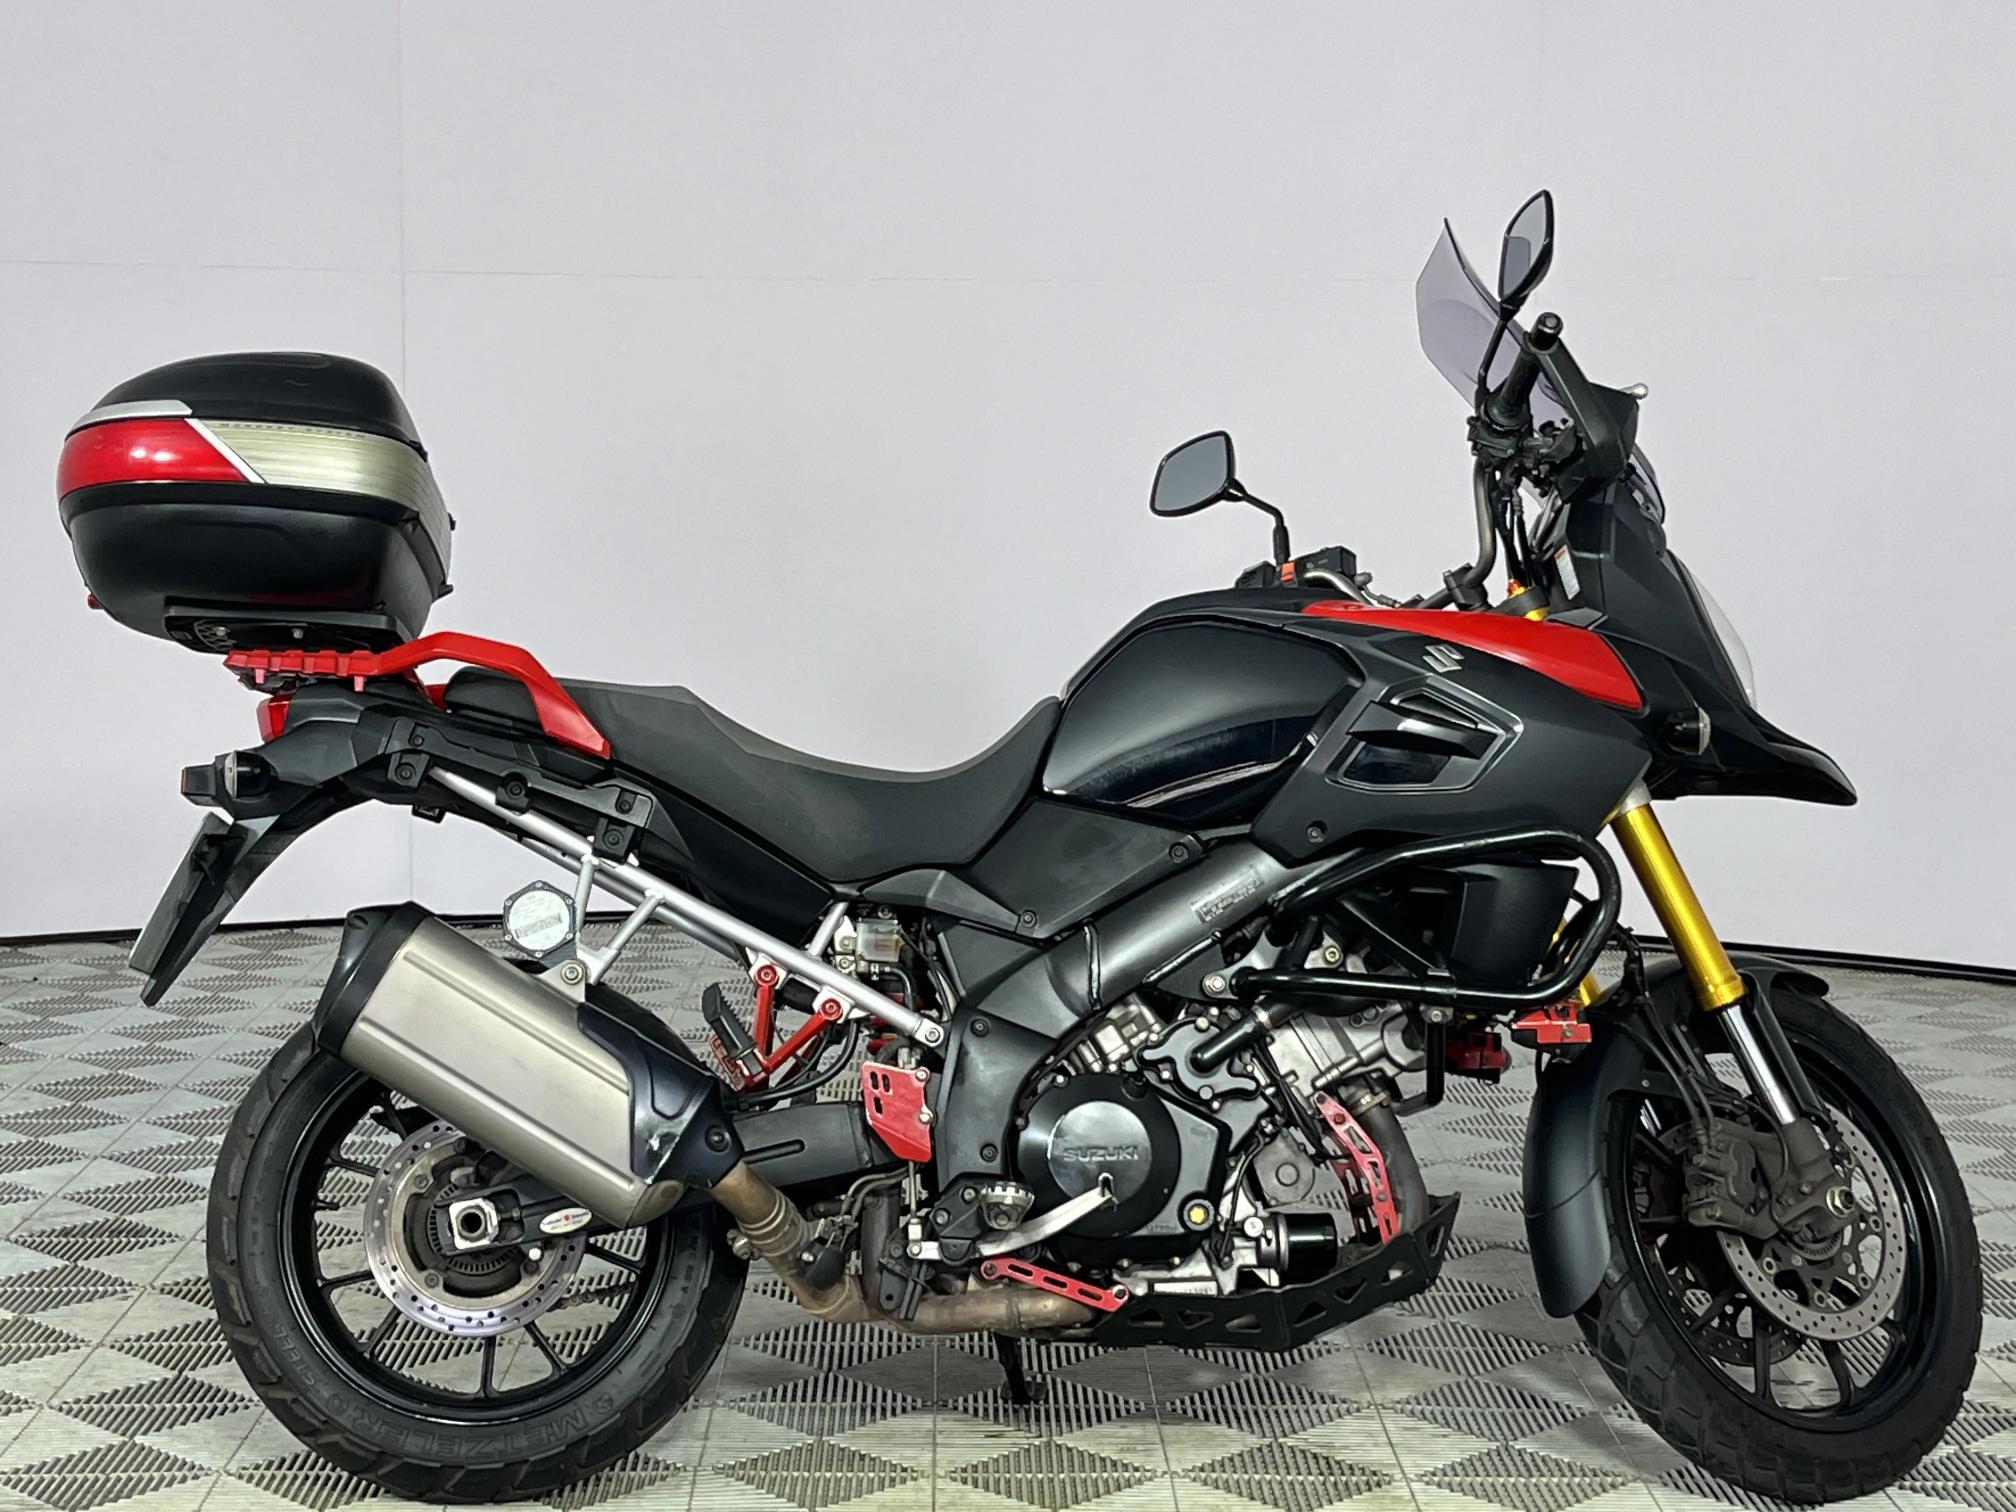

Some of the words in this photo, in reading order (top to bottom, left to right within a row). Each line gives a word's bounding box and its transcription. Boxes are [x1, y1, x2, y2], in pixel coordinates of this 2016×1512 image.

[1062, 1145, 1139, 1162] SUZUKI
[272, 1323, 317, 1386] STEEL
[353, 1406, 590, 1458] METZELER
